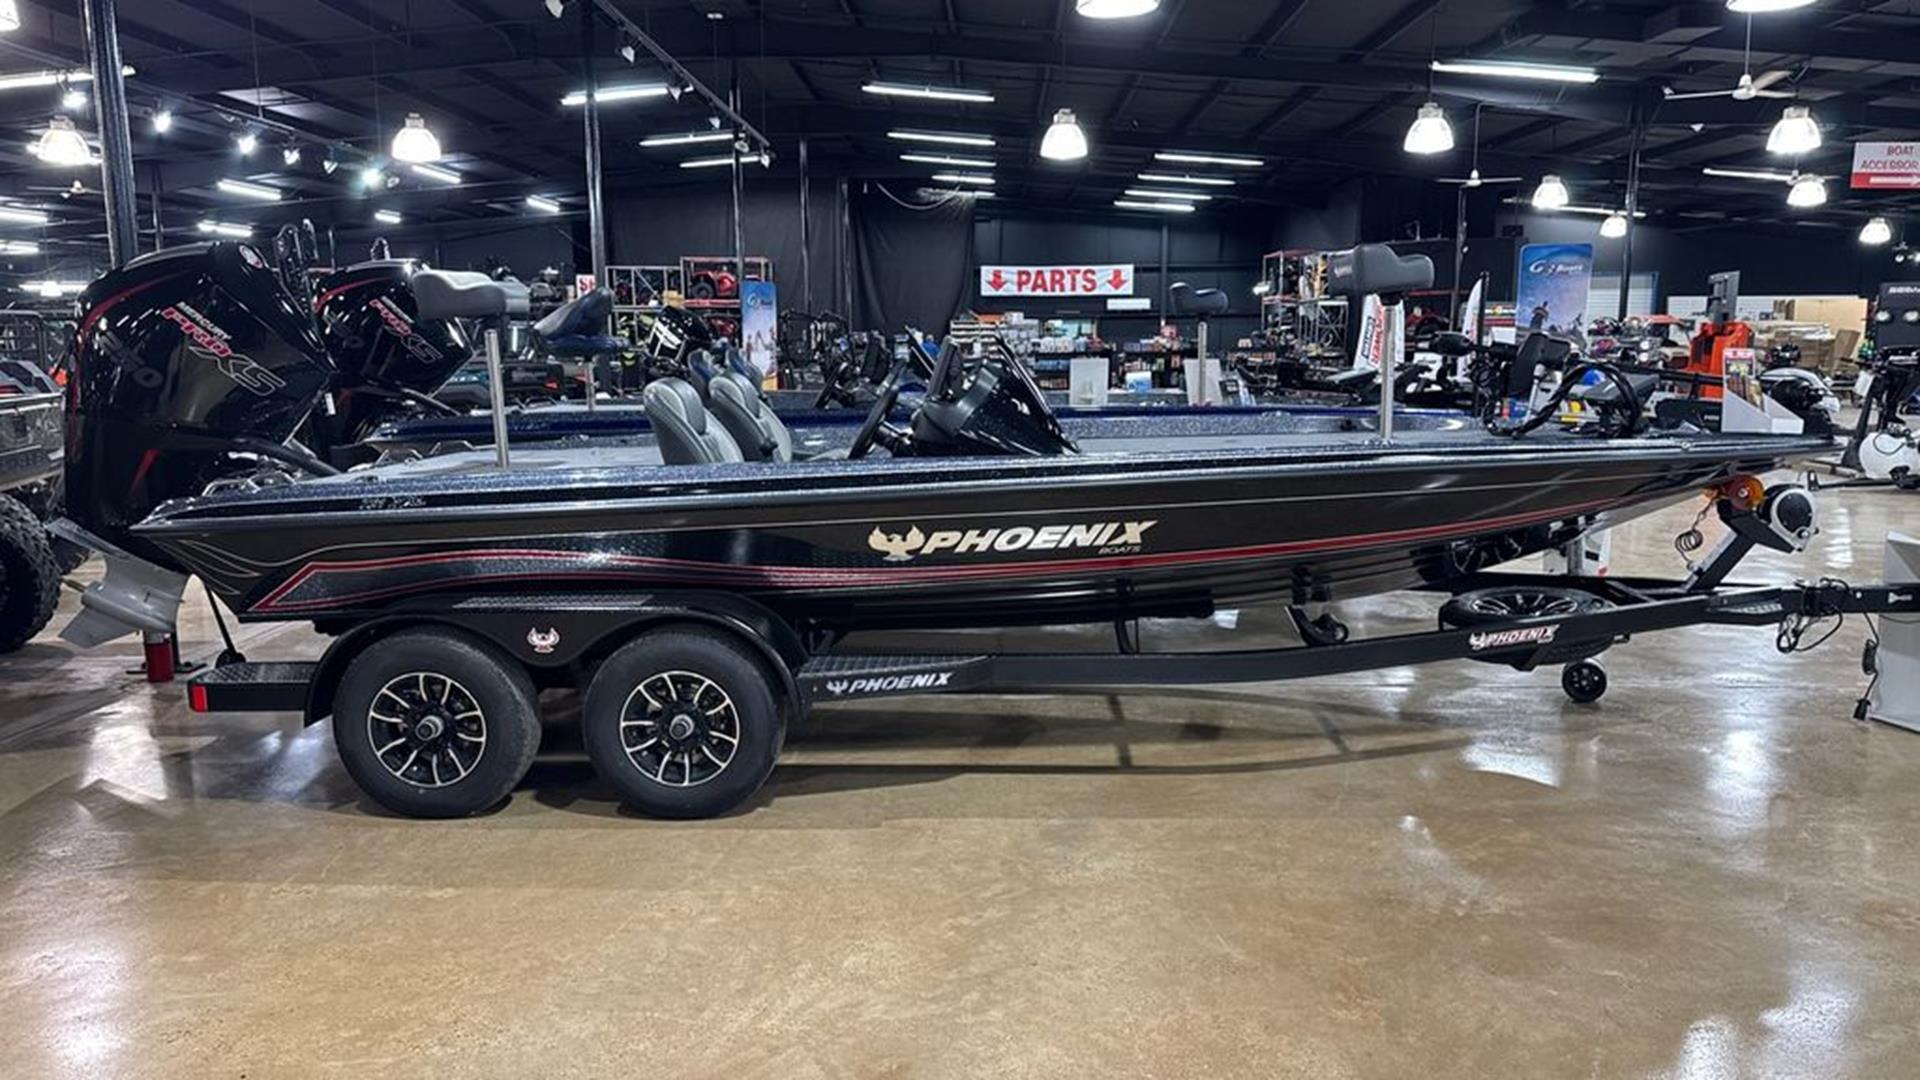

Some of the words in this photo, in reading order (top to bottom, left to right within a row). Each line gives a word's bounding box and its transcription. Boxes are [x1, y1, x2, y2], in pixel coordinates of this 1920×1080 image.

[1887, 145, 1914, 156] BOAT
[1017, 269, 1097, 293] PARTS
[161, 307, 233, 358] PRO
[176, 301, 232, 341] MERCURY
[188, 347, 287, 396] XS
[919, 520, 1158, 555] PHOENIX
[1098, 546, 1142, 555] BOATS
[1488, 624, 1560, 647] PHOENIX
[848, 672, 953, 694] PHOENIX
